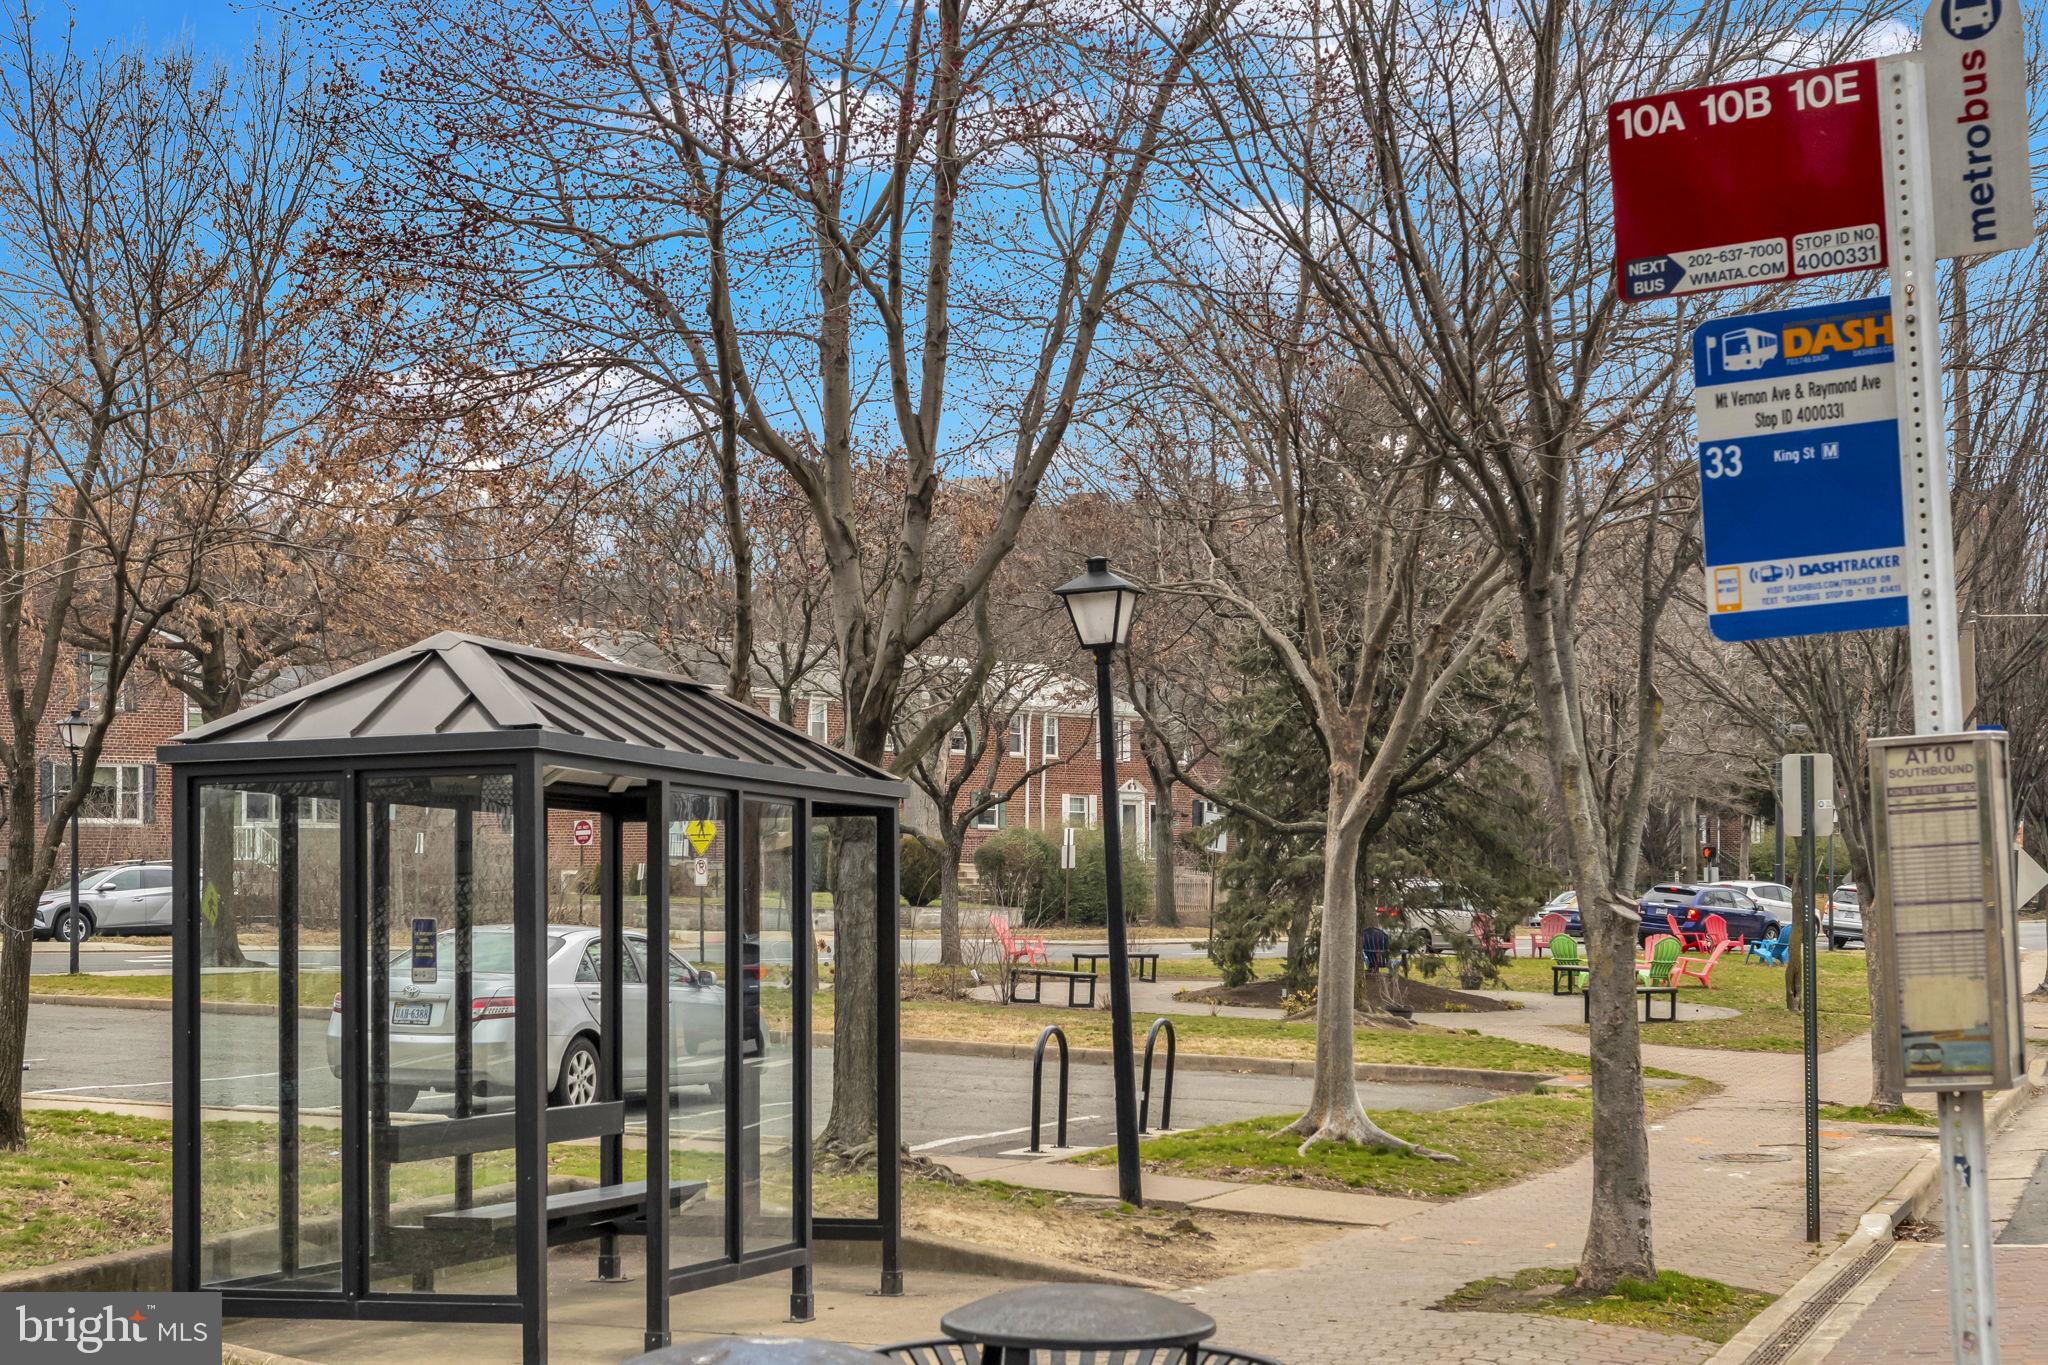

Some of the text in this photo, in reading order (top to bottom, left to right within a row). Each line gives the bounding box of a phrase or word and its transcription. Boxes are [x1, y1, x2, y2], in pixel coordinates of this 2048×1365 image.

[1617, 70, 1860, 139] 10A 10B 10E
[1957, 49, 1997, 242] metrobus
[1795, 228, 1879, 251] STOP ID NO.
[1628, 259, 1668, 276] NEXT
[1688, 242, 1783, 268] 202-637-7000
[1796, 245, 1877, 271] 4000331
[1690, 261, 1785, 286] WMATA.COM
[1634, 278, 1665, 295] BUS
[1782, 315, 1894, 359] DASH
[1715, 375, 1881, 409] Mt Vernon Ave & Raymond Ave
[1755, 403, 1845, 429] Stop ID 4000331
[1705, 445, 1743, 479] 33
[1774, 449, 1800, 464] King
[1803, 447, 1815, 459] St
[1799, 554, 1900, 577] DASHTRACKER
[1905, 746, 1955, 765] AT10
[1888, 764, 1974, 779] SOUTHBOUND
